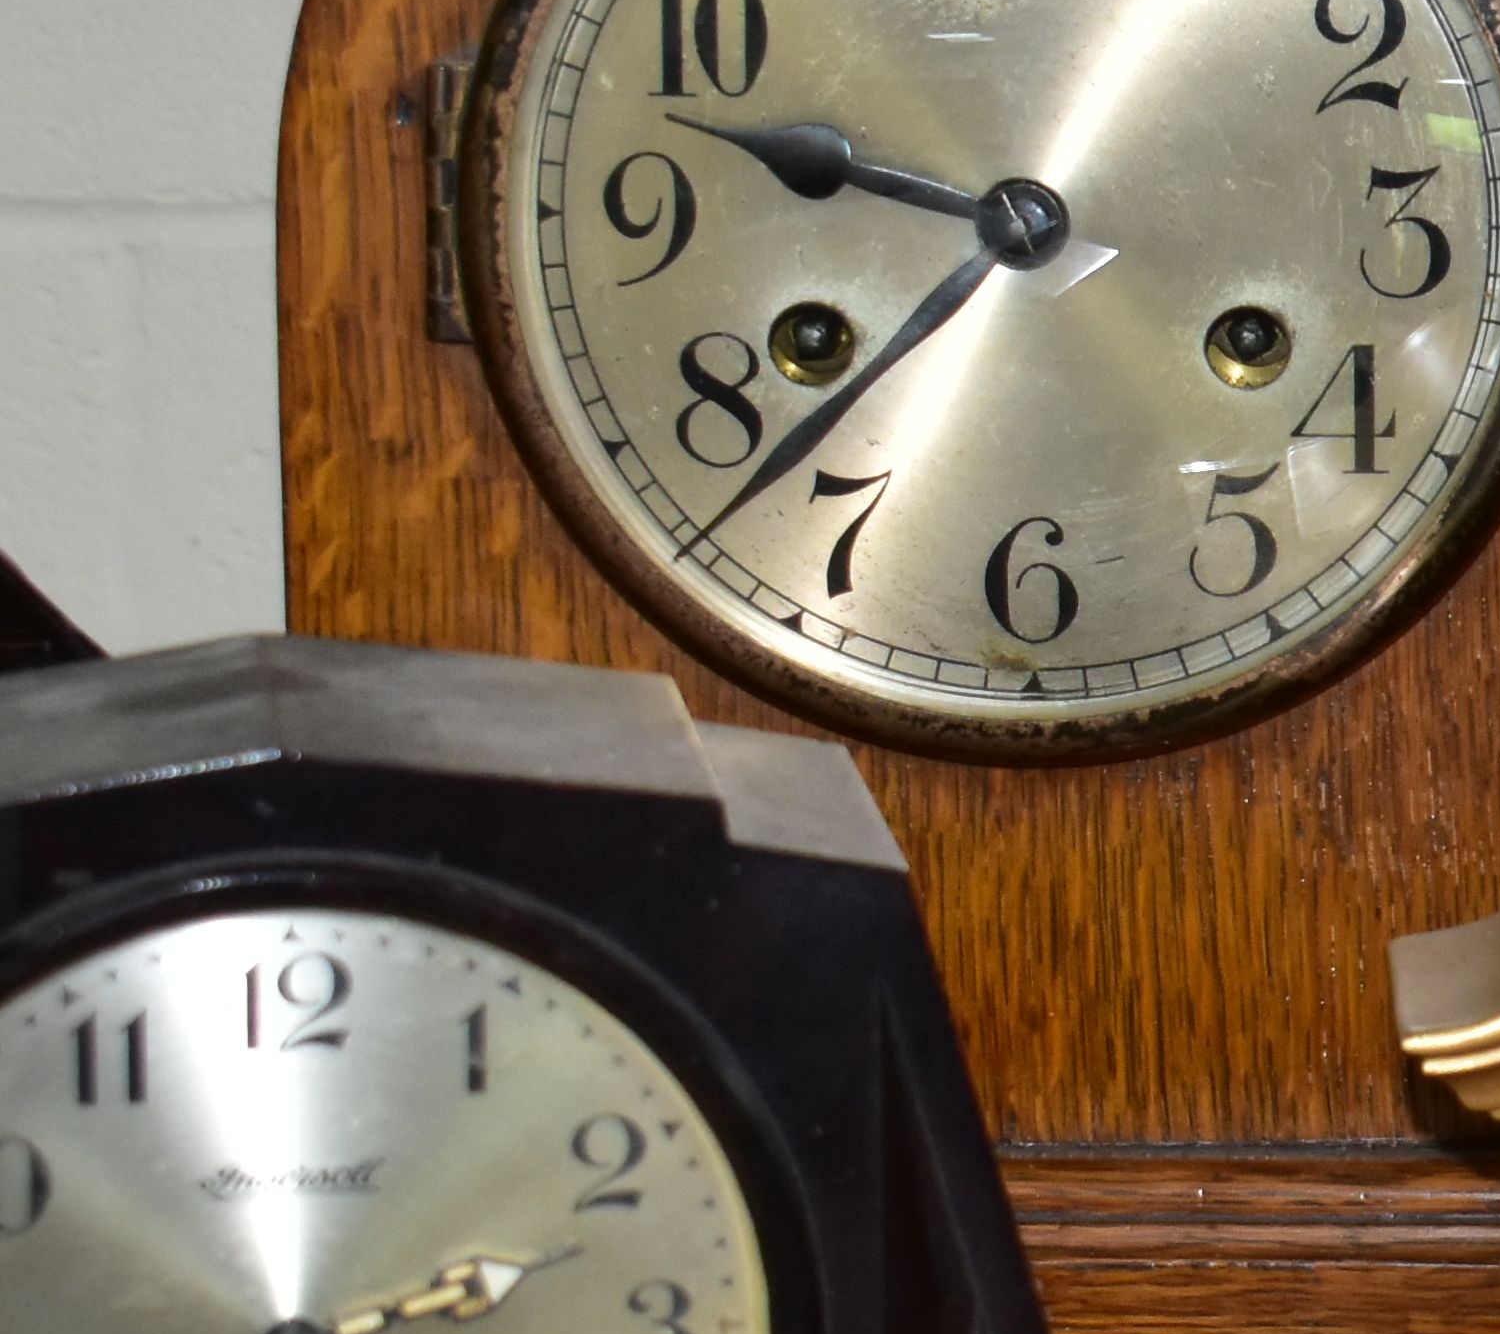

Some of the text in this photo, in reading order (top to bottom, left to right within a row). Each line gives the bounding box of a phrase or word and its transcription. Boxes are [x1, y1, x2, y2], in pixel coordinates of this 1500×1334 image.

[602, 151, 698, 287] 9
[1359, 165, 1452, 299] 3
[676, 331, 763, 468] 8
[1289, 342, 1397, 475] 4
[808, 470, 892, 599] 7
[983, 516, 1080, 644] 6
[1189, 464, 1281, 598] 5
[70, 1009, 148, 1105] 11
[244, 950, 354, 1051] 12
[460, 1003, 489, 1092] 1
[198, 1156, 385, 1201] Inersoll
[571, 1113, 647, 1213] 2
